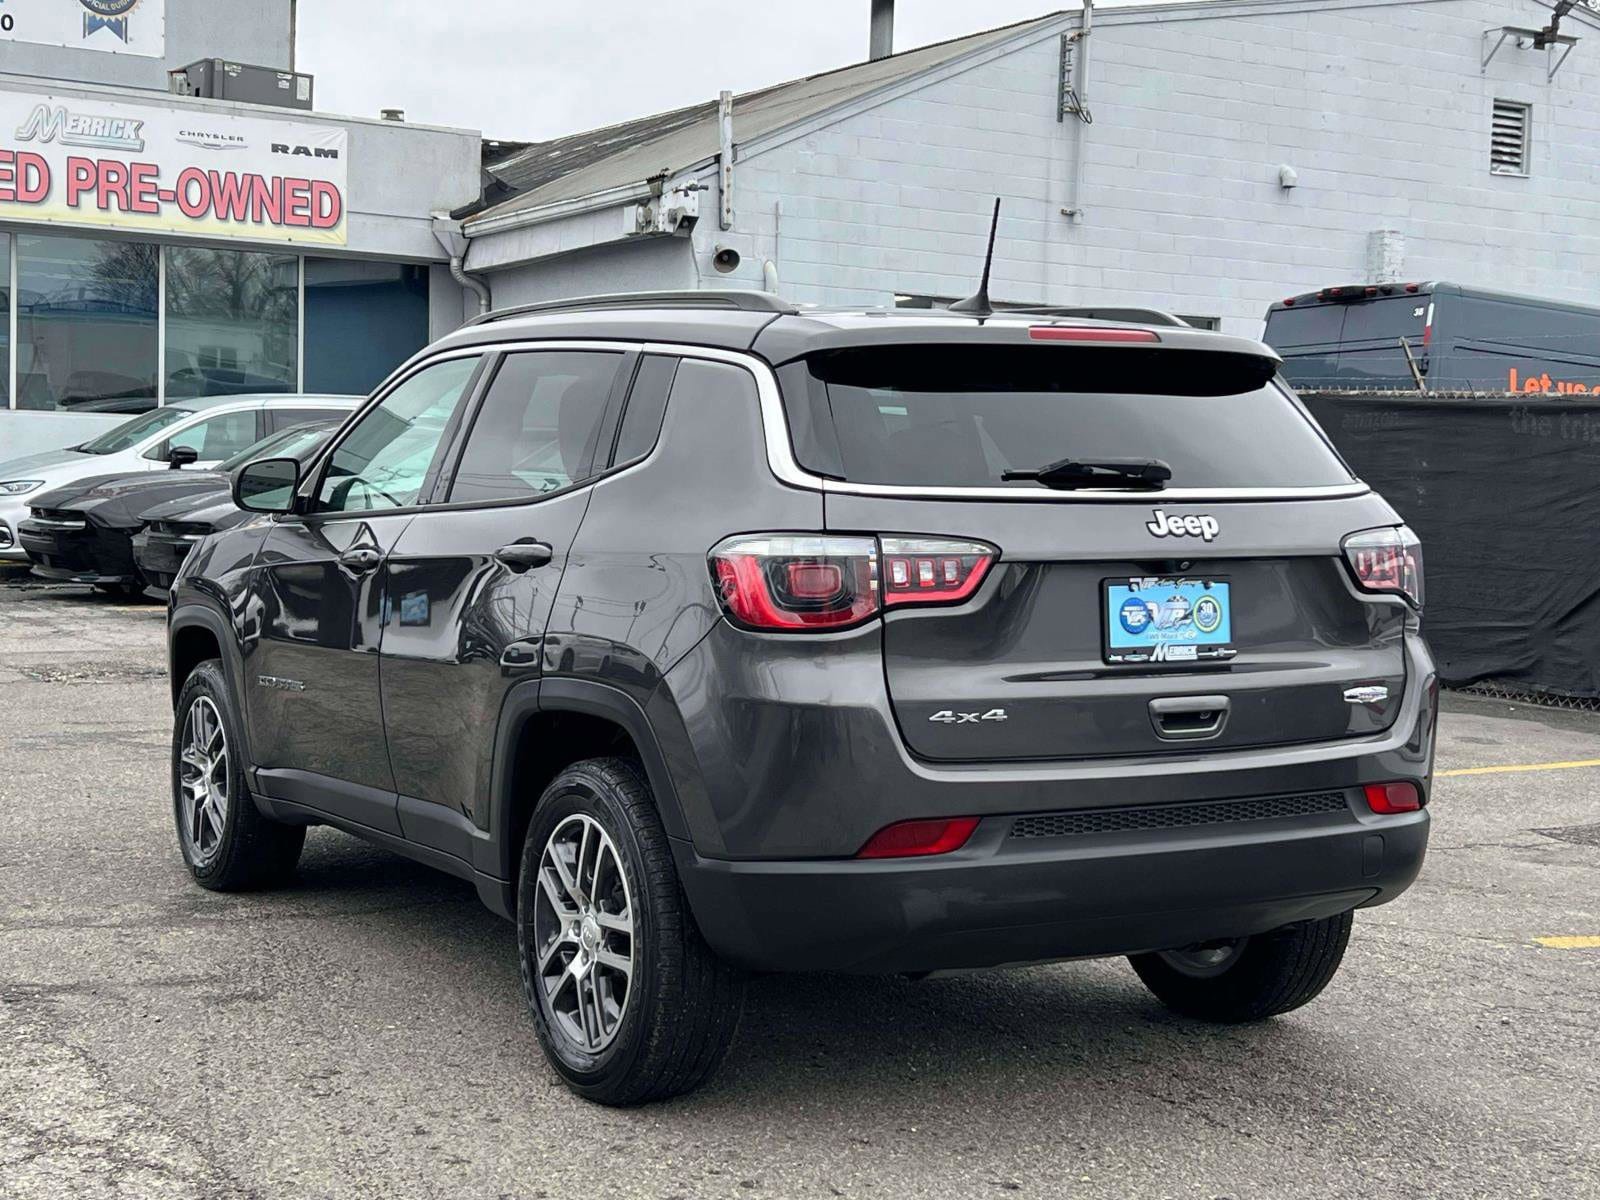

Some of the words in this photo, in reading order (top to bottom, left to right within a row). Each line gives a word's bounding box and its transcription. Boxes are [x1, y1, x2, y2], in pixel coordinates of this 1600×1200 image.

[179, 130, 244, 142] CHRYSLER
[271, 143, 339, 159] RAM
[66, 156, 342, 229] PRE-OWNED
[1146, 508, 1220, 543] Jeep
[928, 708, 1008, 724] 4x4
